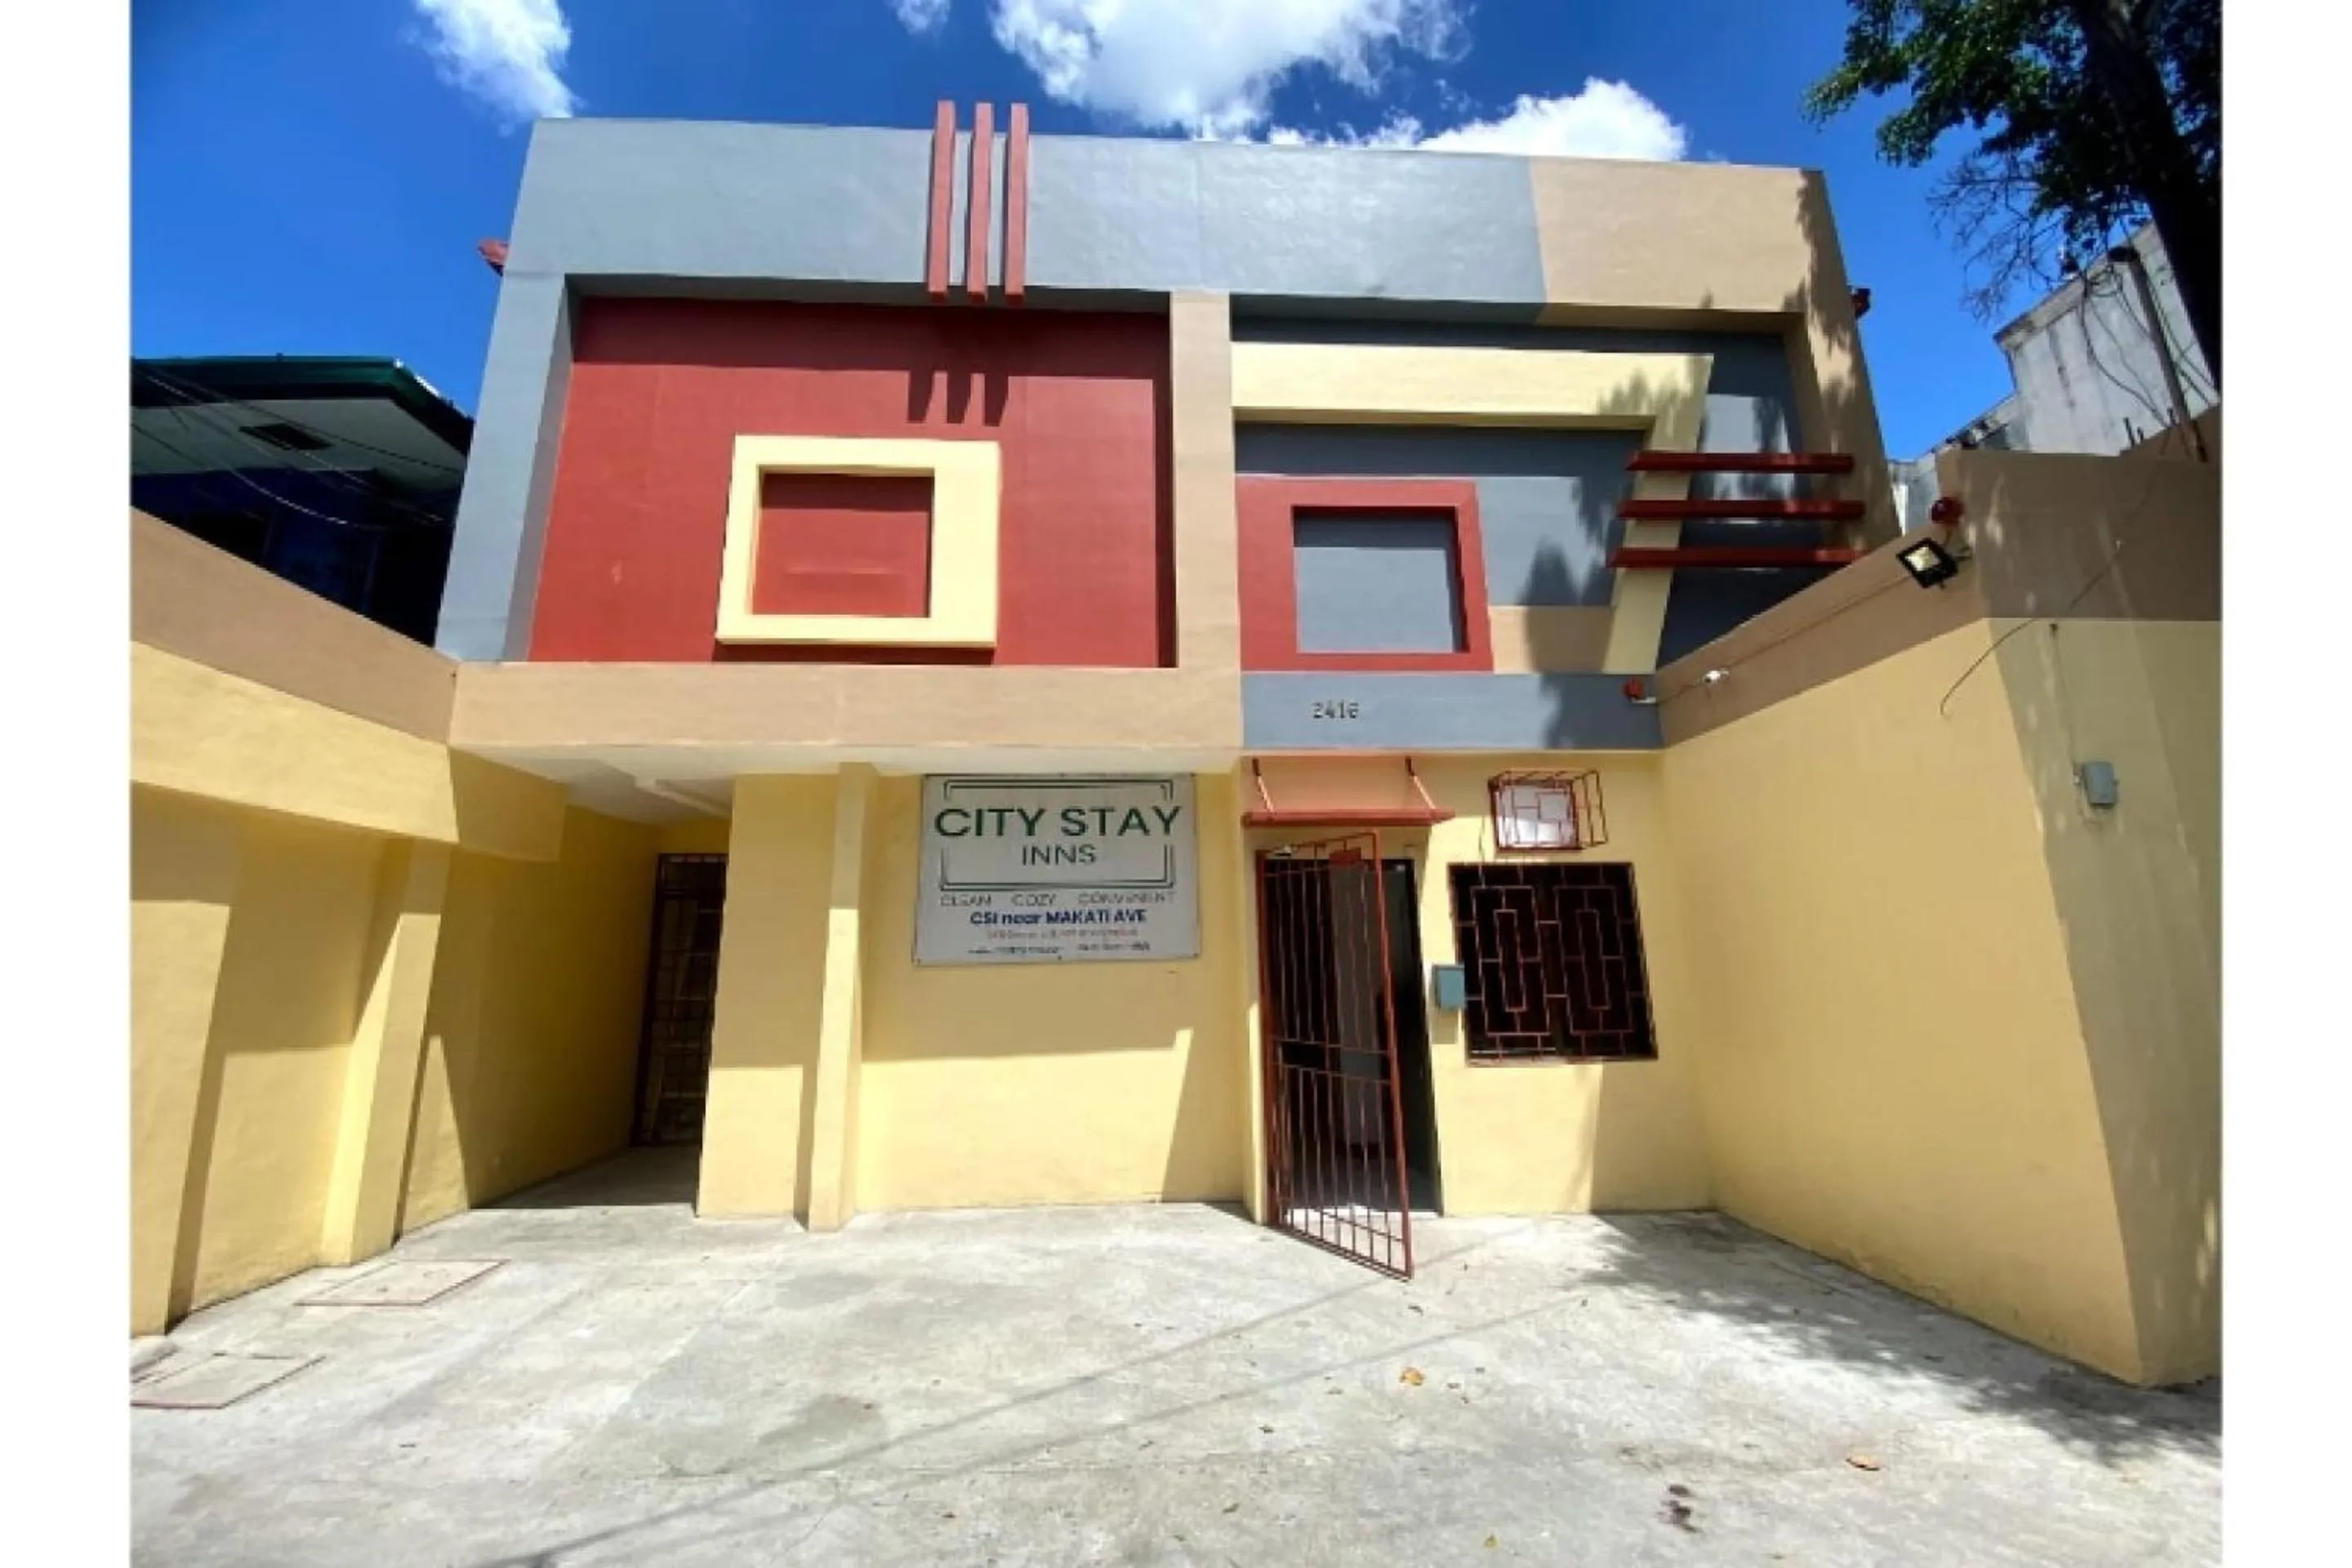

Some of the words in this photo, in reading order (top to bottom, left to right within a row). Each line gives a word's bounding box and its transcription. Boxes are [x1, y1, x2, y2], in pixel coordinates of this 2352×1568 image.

[934, 808, 1046, 837] CITY
[1061, 805, 1182, 836] STAY
[1022, 844, 1097, 866] INNS
[940, 893, 991, 906] CLEAN
[1011, 893, 1057, 906] COZY
[970, 911, 997, 924] CSI
[1002, 913, 1041, 924] near
[1045, 909, 1109, 924] MAKATI
[1113, 908, 1147, 923] AVE
